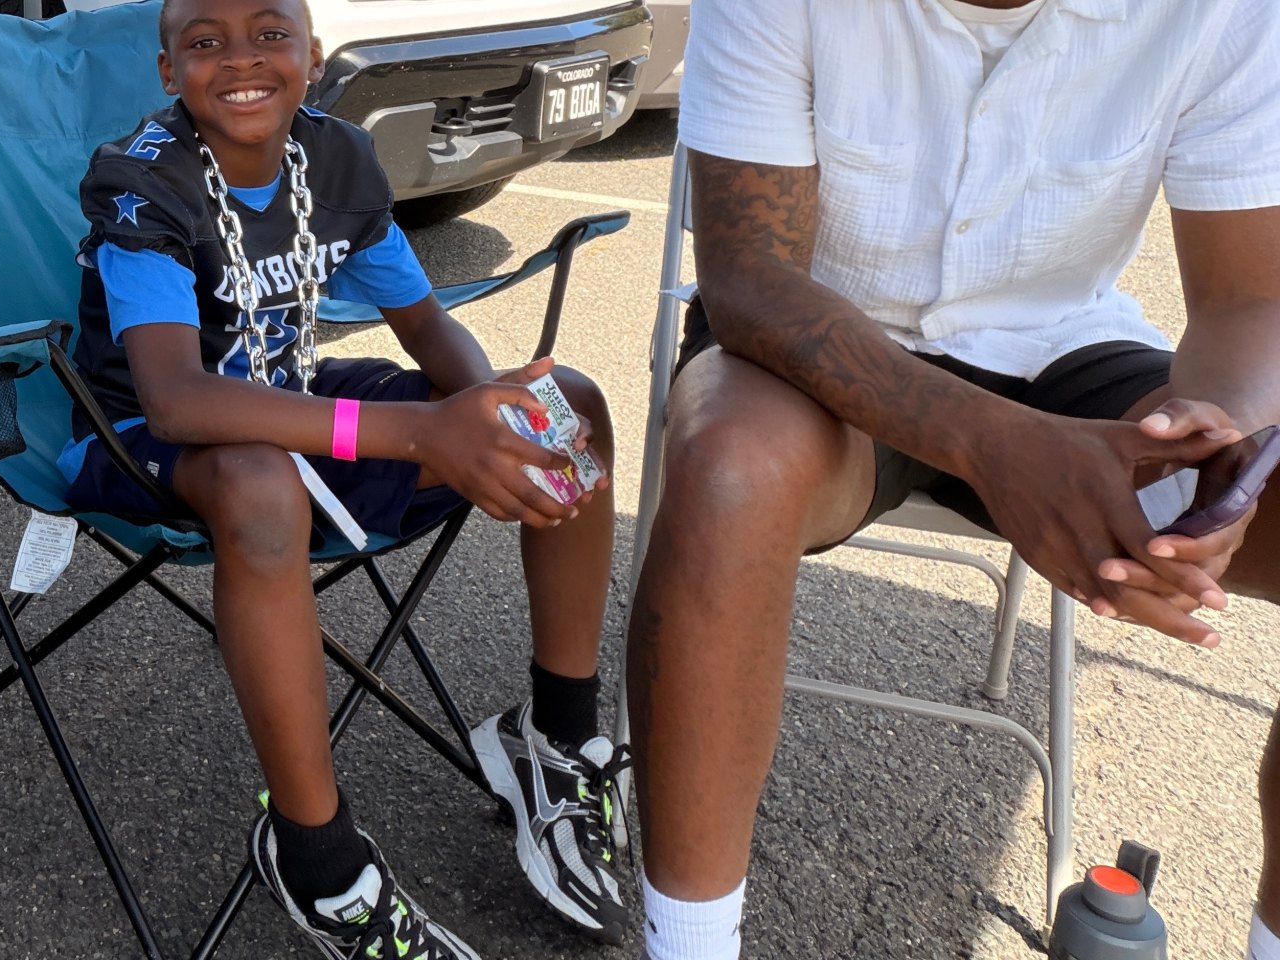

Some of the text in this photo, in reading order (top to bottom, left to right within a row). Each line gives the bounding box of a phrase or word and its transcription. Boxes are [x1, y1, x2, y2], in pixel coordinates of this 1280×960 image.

[562, 67, 594, 83] COLORADO
[549, 88, 566, 125] 79
[541, 387, 566, 420] Juice
[545, 381, 574, 420] Juicy
[341, 901, 366, 922] NIKE
